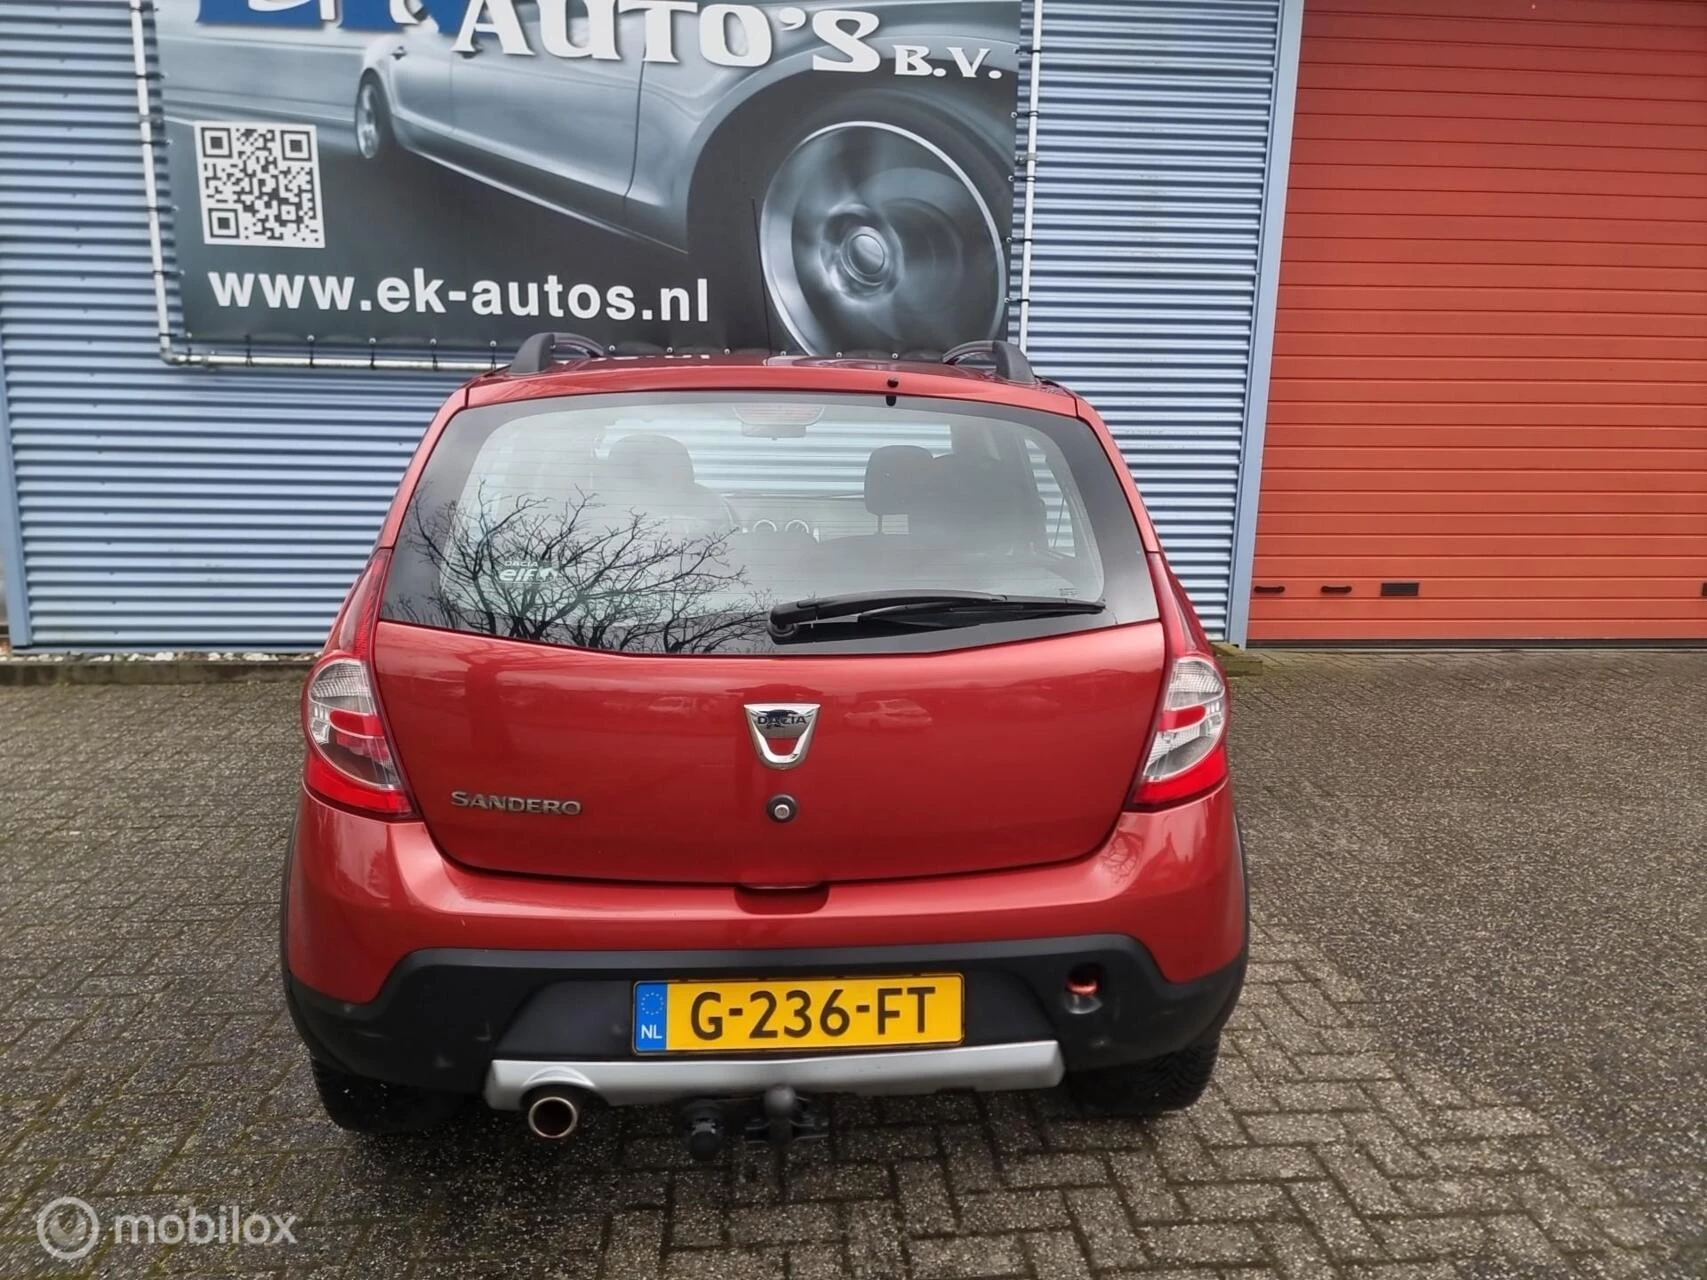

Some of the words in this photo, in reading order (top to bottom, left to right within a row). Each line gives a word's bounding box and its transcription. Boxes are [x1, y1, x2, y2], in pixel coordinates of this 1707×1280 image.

[892, 44, 1002, 79] B.V.
[207, 267, 709, 323] www.ek-autos.nl
[757, 715, 807, 725] DACIA
[450, 790, 584, 817] SANDERO
[690, 986, 936, 1041] G-236-FT
[641, 1024, 663, 1040] NL
